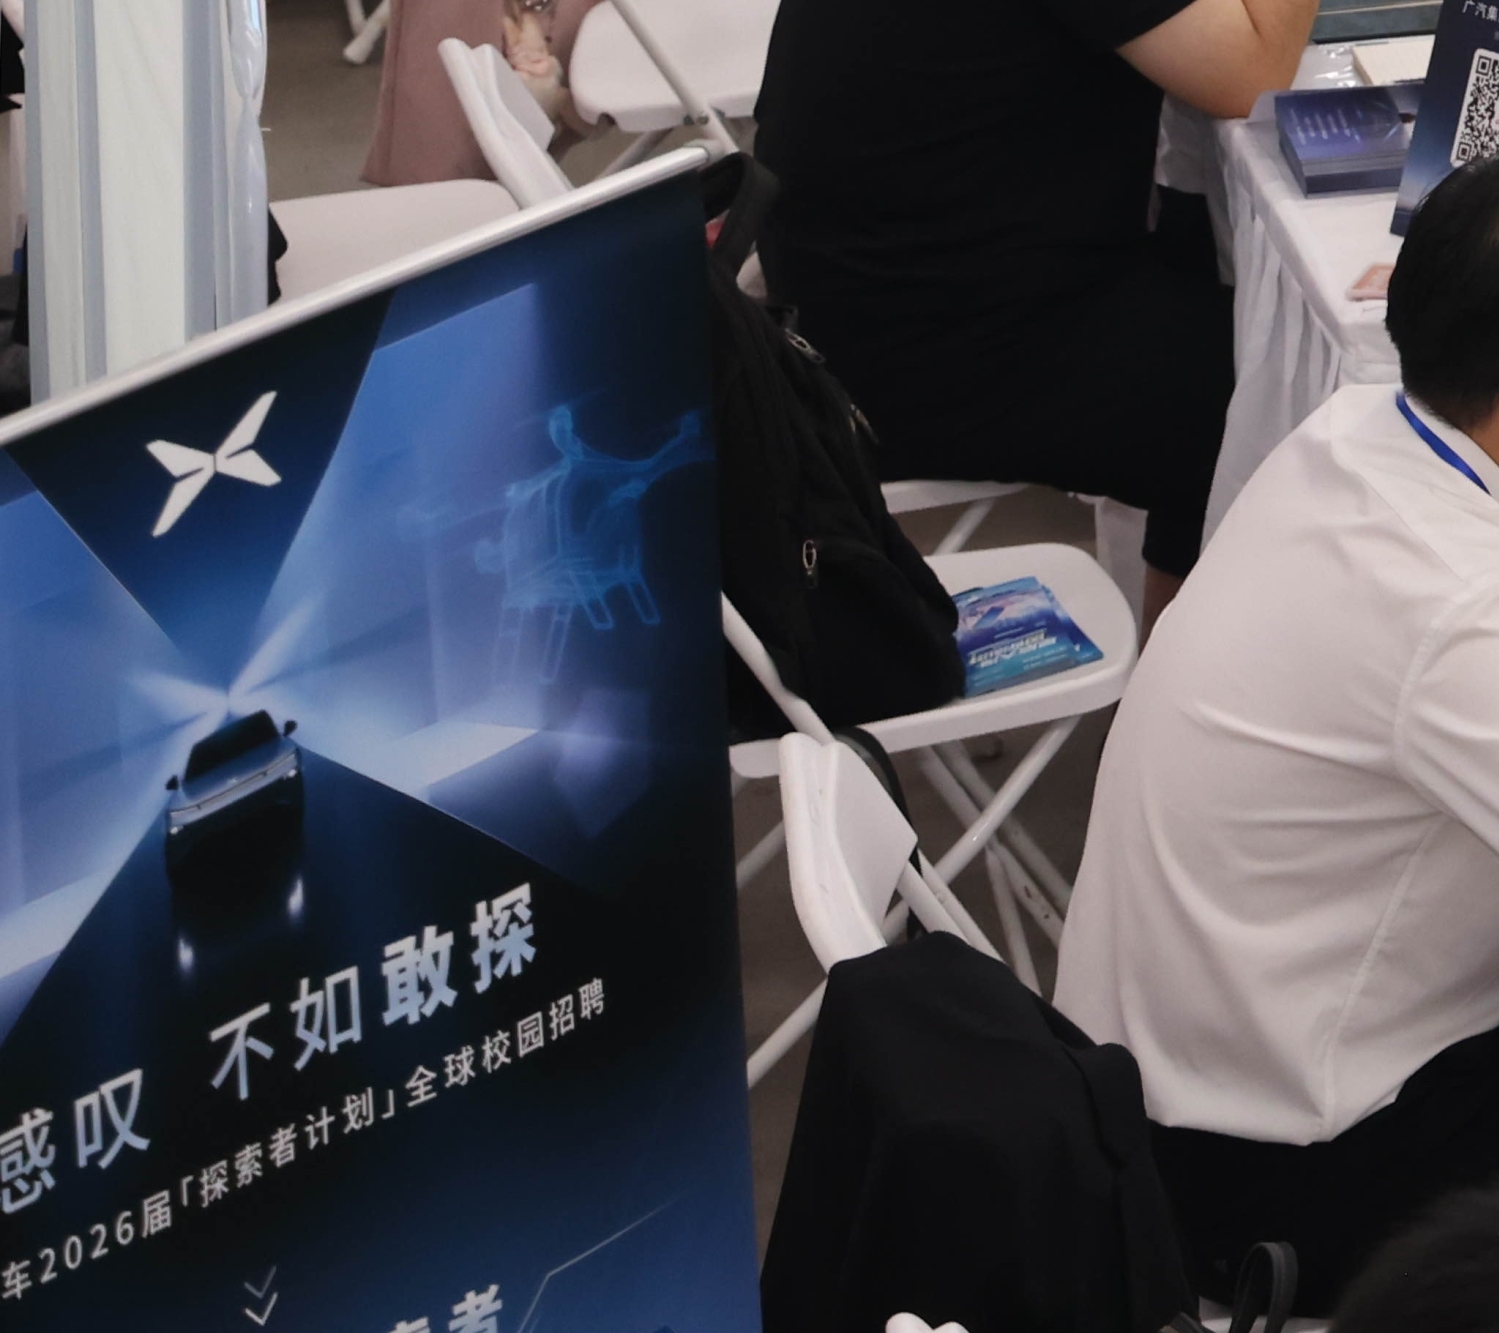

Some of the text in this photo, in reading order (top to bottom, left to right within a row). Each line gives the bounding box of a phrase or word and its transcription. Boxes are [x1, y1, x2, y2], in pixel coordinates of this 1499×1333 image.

[0, 882, 538, 1215] 感叹 不如敢探
